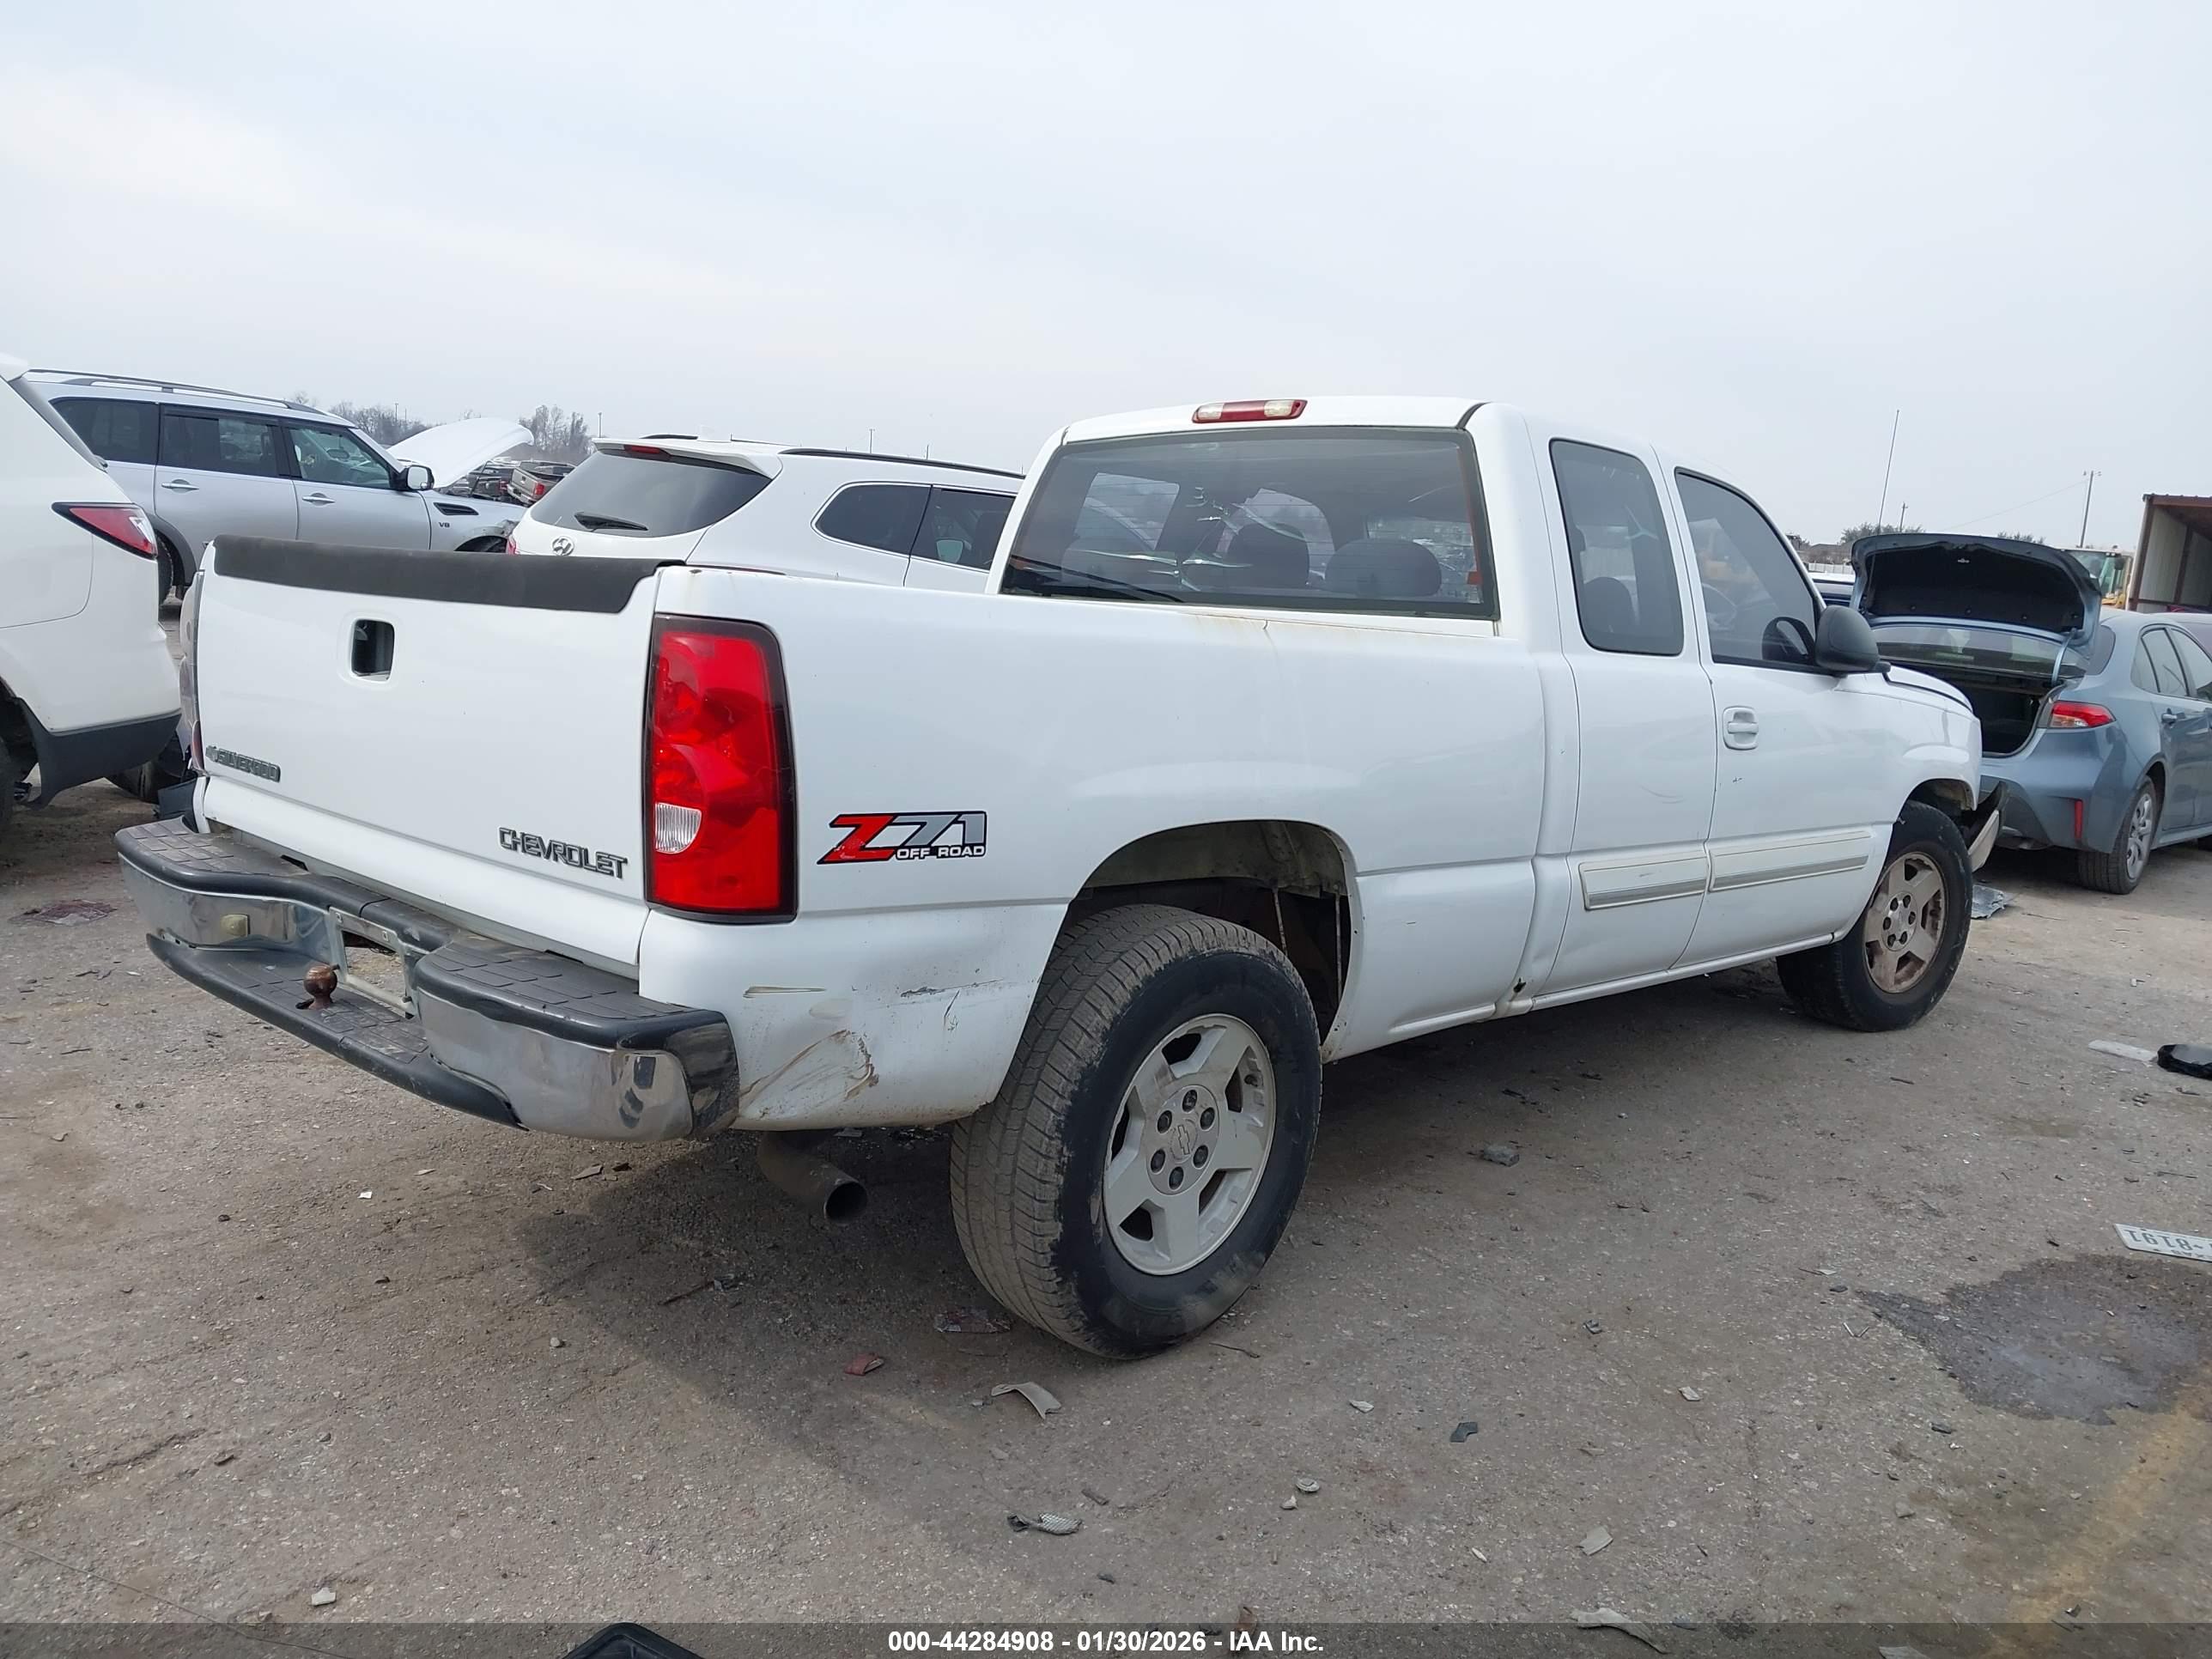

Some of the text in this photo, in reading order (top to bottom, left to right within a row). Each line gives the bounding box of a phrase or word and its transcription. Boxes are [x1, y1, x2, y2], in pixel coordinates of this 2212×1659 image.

[498, 827, 629, 879] CHEVROLET
[817, 811, 987, 865] Z71
[896, 845, 985, 860] OFF ROAD
